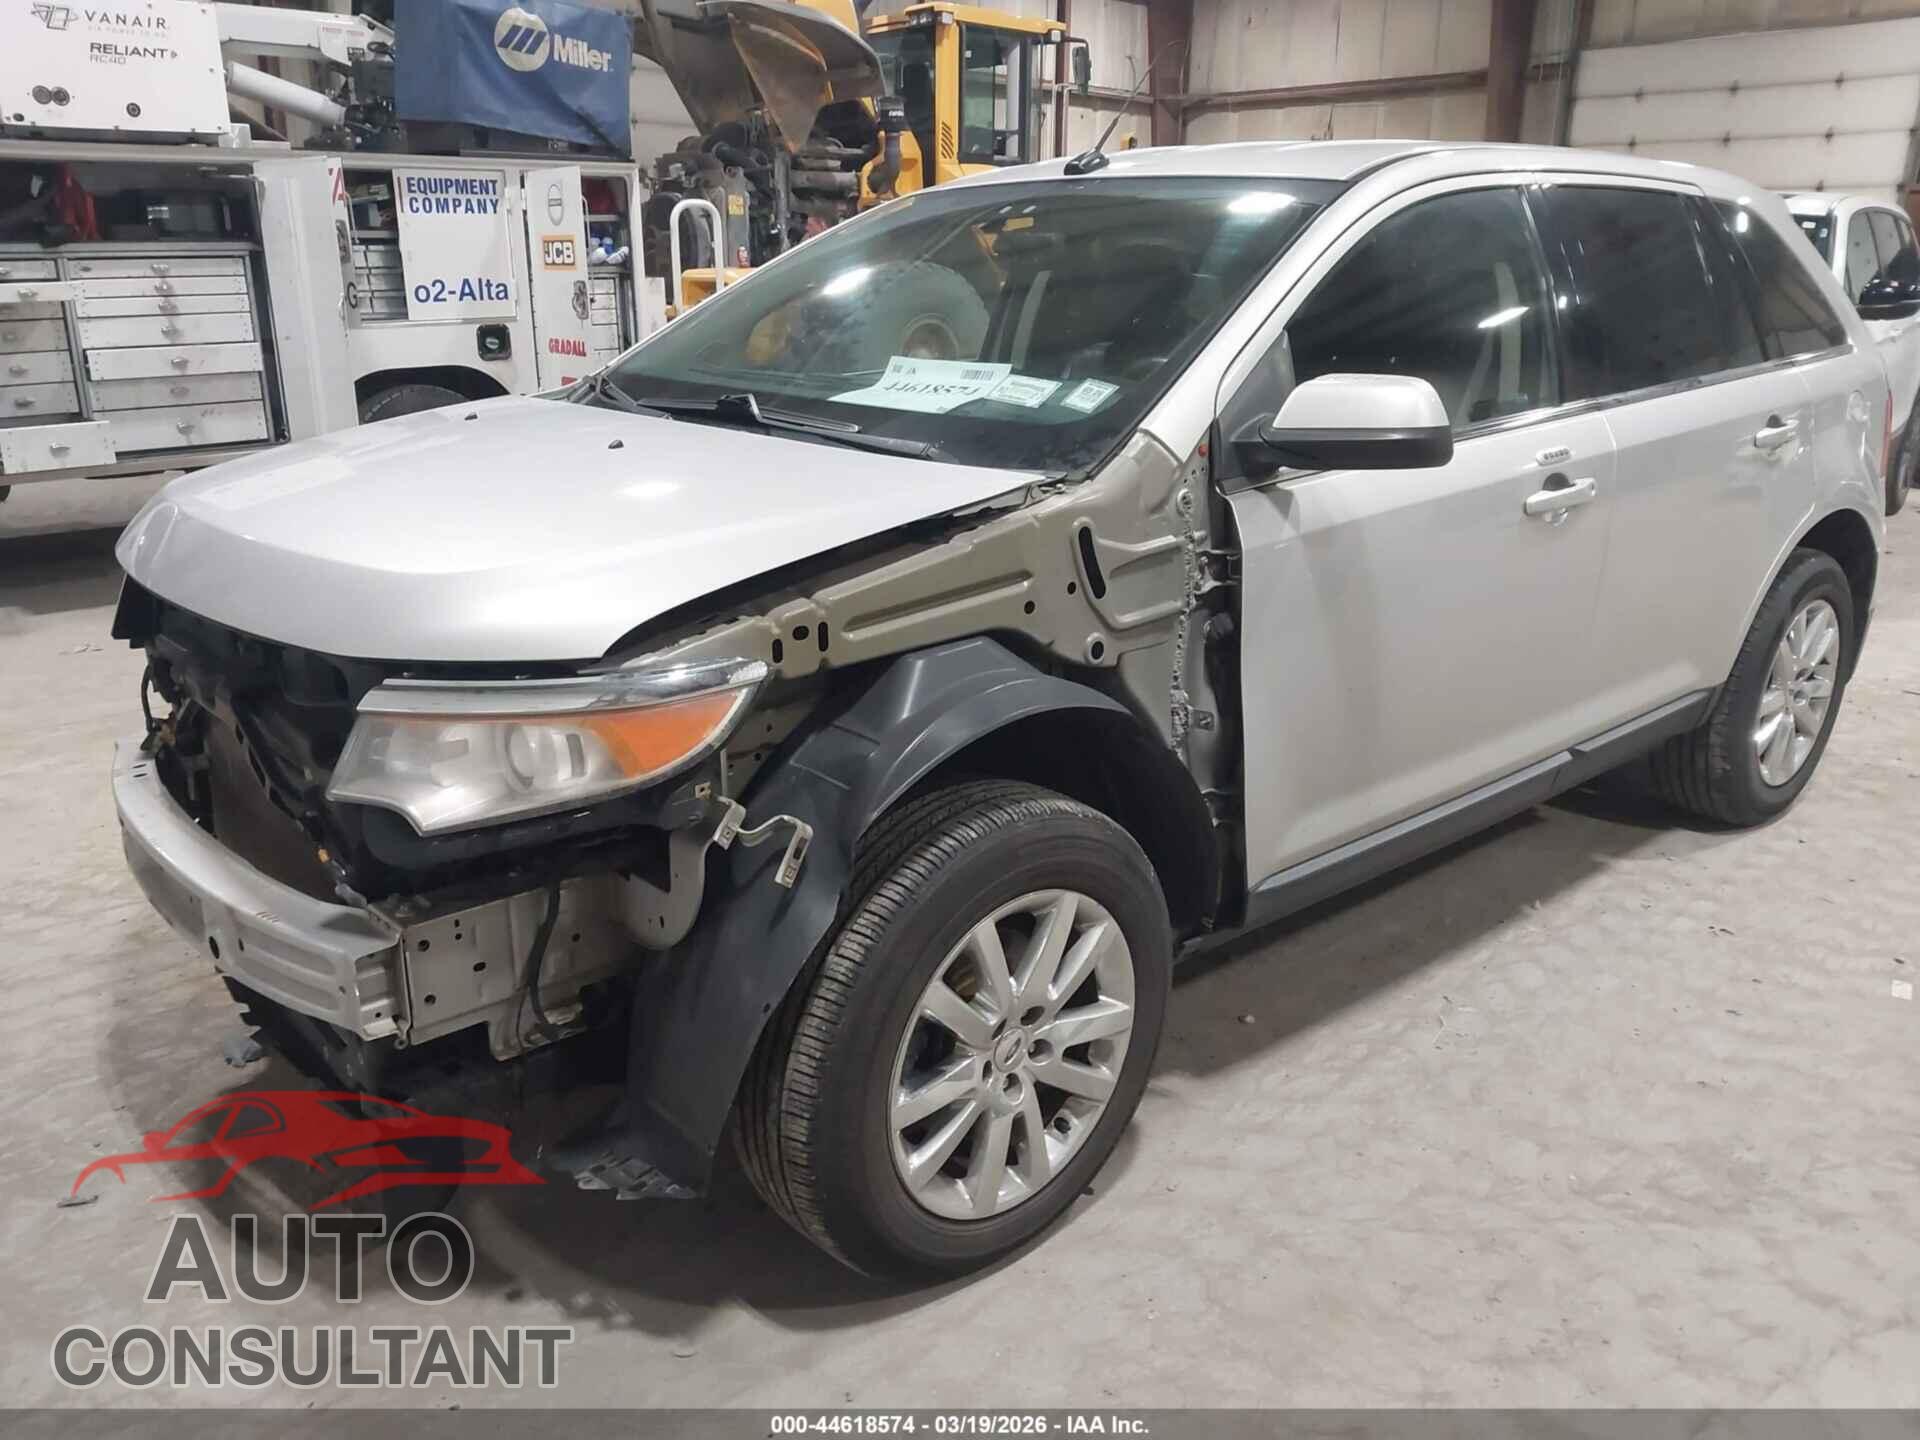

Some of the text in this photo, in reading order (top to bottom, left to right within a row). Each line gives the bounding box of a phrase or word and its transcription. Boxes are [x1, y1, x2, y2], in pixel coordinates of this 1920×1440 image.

[84, 9, 168, 30] VANAIR
[89, 42, 169, 59] RELIANT
[553, 33, 611, 72] Miller
[406, 176, 498, 196] EQUIPMENT
[409, 197, 500, 214] COMPANY
[544, 240, 575, 264] JCB
[414, 277, 509, 303] o2-Alta
[549, 338, 586, 357] GRADALL
